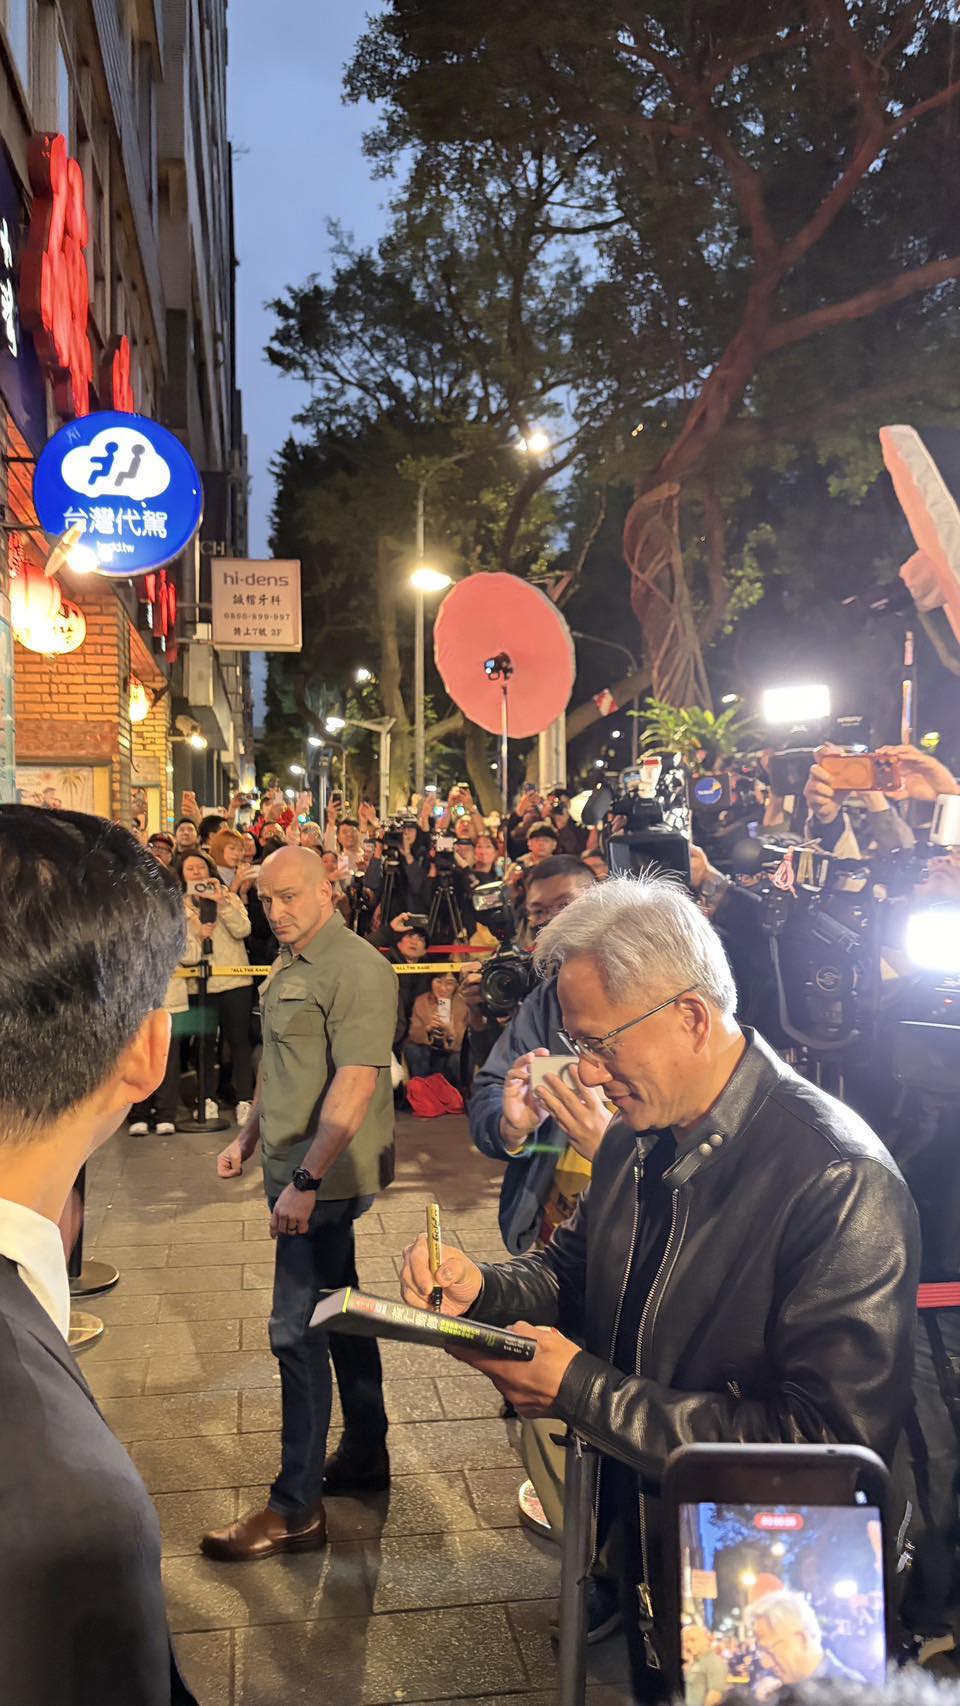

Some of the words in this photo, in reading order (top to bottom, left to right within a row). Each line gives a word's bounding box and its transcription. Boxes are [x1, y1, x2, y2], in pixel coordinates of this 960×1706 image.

[63, 506, 168, 539] 台灣代駕
[223, 571, 289, 587] hi-dens
